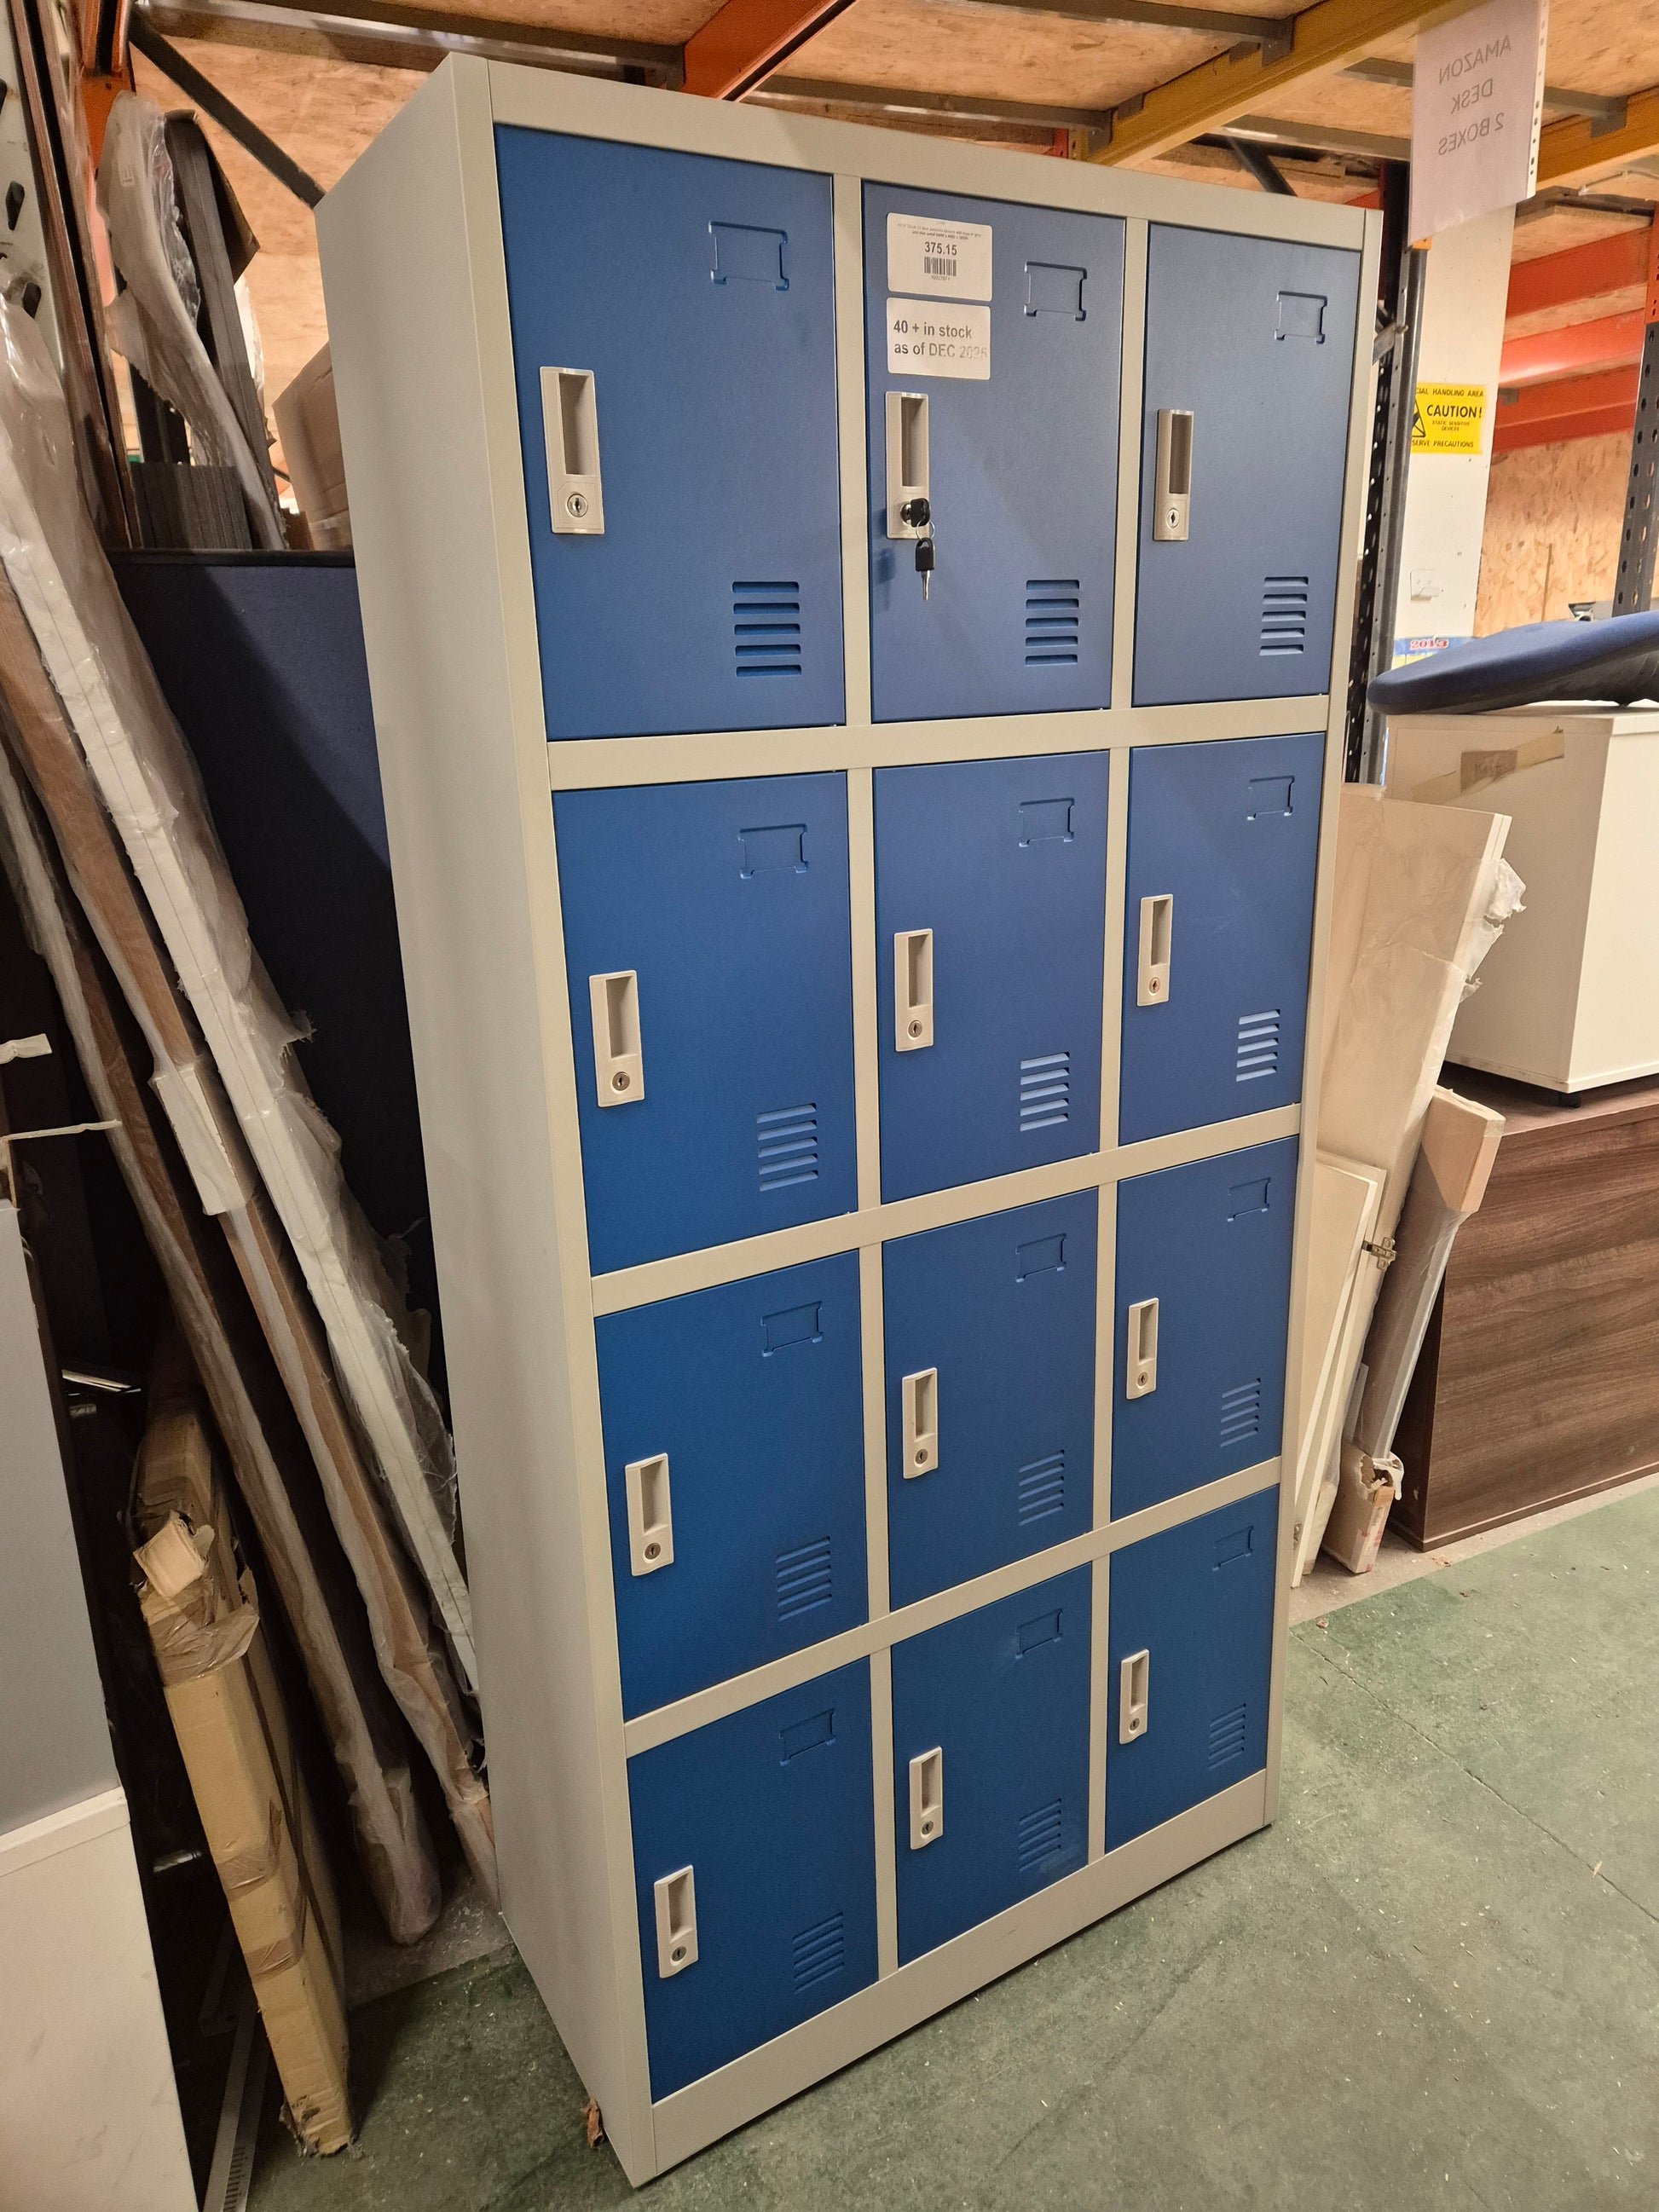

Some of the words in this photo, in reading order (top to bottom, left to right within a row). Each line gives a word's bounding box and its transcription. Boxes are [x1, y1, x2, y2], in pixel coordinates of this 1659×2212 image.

[924, 241, 957, 257] 375.15
[893, 320, 908, 333] 40
[912, 323, 920, 332] +
[923, 321, 935, 336] in
[939, 325, 972, 338] stock
[894, 343, 909, 355] as
[912, 342, 925, 355] of
[928, 343, 956, 358] DEC
[1426, 405, 1482, 418] CAUTION!
[1433, 440, 1474, 448] PRECAUTIONS
